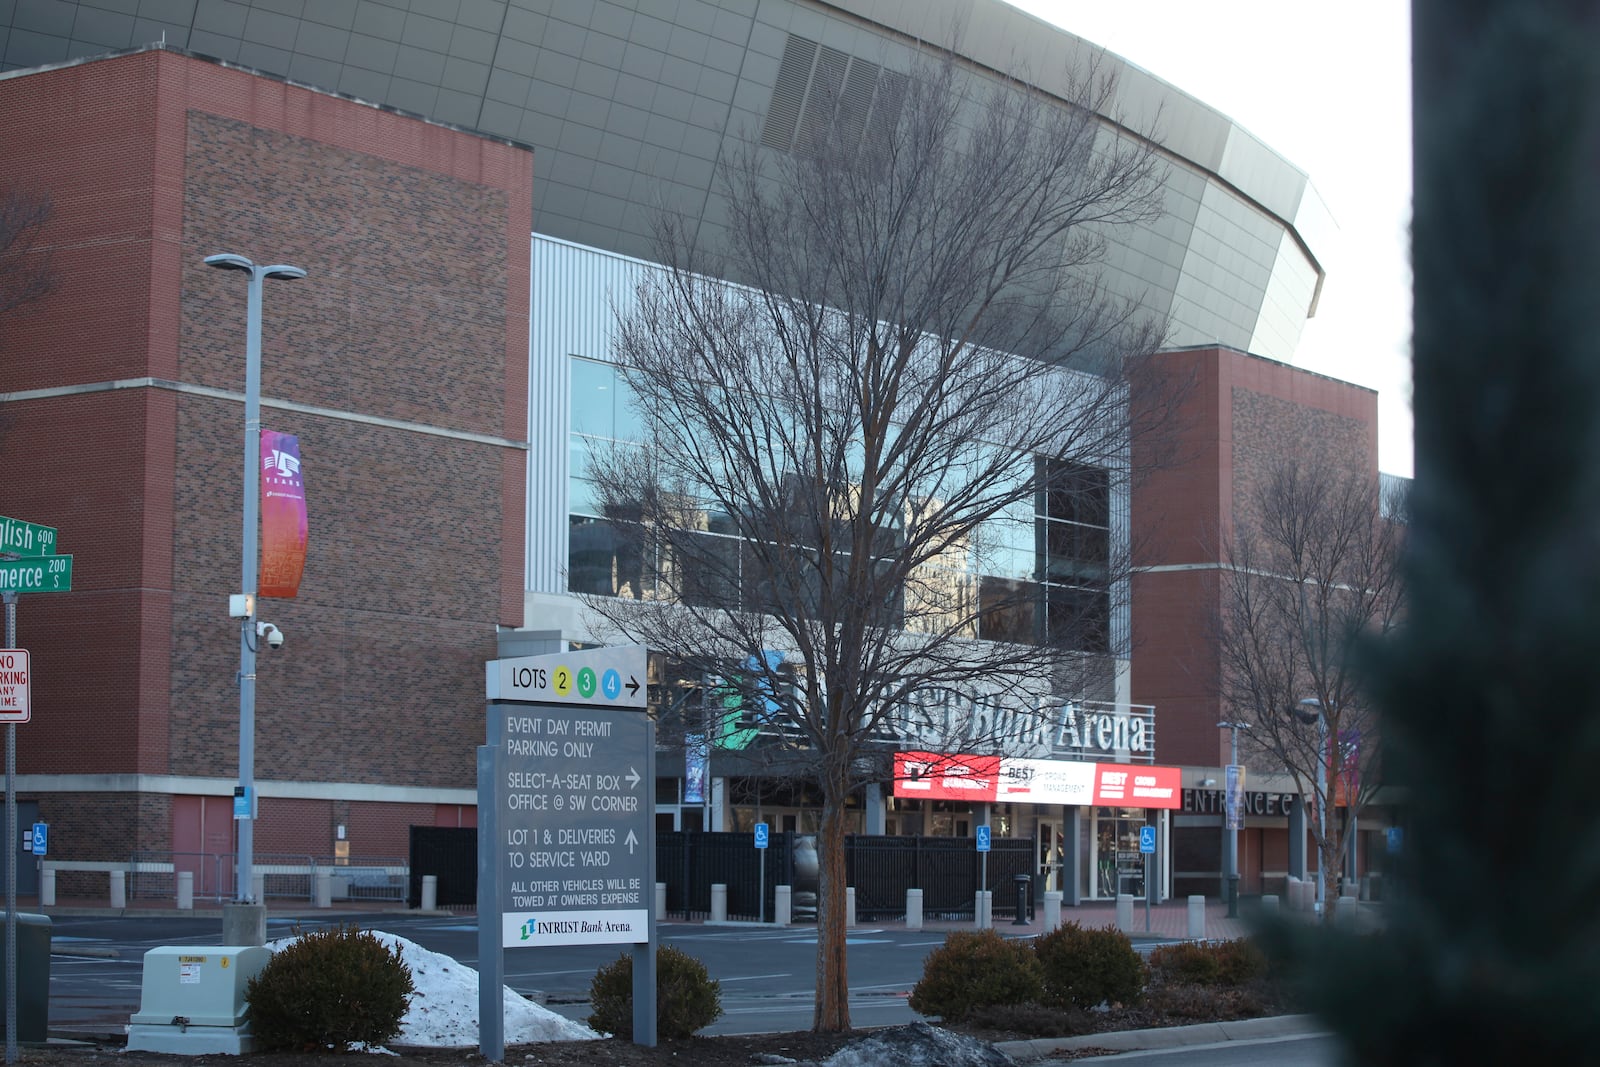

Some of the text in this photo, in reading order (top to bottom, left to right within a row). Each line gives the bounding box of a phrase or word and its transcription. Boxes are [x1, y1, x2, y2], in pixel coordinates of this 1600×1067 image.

[37, 530, 53, 545] 600
[48, 559, 66, 573] 200
[53, 574, 60, 588] S
[512, 667, 616, 693] LOTS 2 3 4
[507, 716, 612, 737] EVENT DAY PERMIT
[1057, 700, 1147, 752] Arena
[507, 739, 594, 758] PARKING ONLY
[508, 771, 620, 791] SELECT-A-SEAT BOX
[1008, 767, 1035, 780] BEST
[508, 793, 638, 812] OFFICE @ SW CORNER
[1184, 789, 1274, 815] ENTRNCE
[508, 828, 616, 845] LOT 1 & DELIVERIES
[508, 850, 610, 869] TO SERVICE YARD
[511, 878, 641, 893] ALL OTHER VEHICLES WILL BE
[512, 892, 639, 908] TOWED AT OWNERS EXPENSE
[538, 921, 579, 934] INTRUST
[580, 920, 603, 933] Bank
